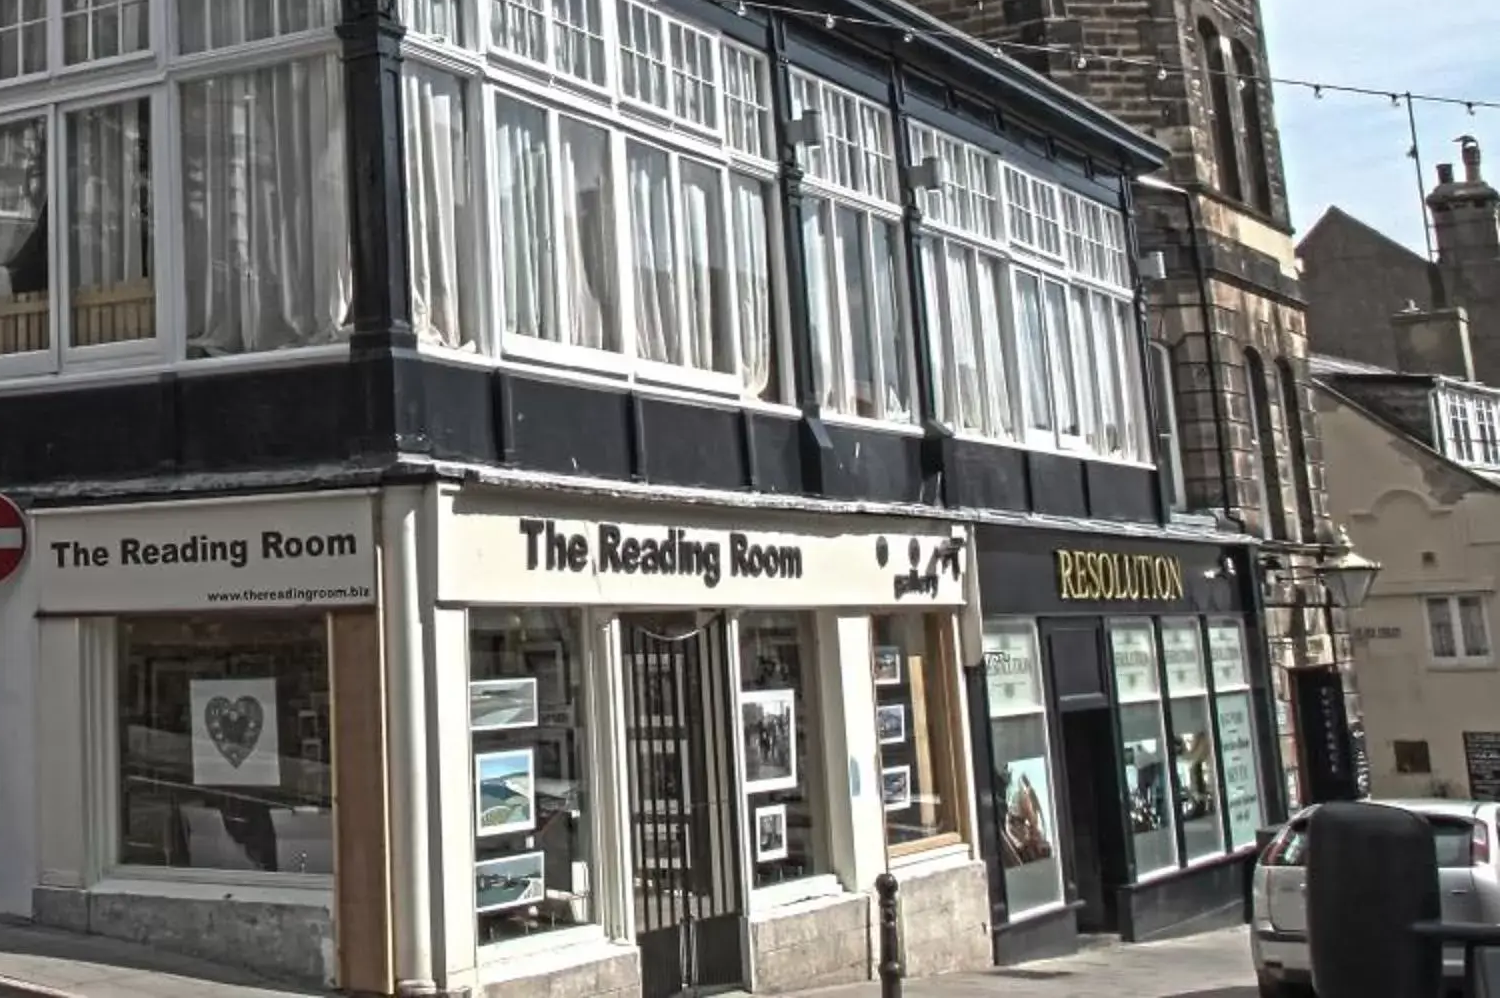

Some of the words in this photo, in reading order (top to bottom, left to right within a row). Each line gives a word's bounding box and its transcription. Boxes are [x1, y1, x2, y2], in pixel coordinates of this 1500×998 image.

[50, 541, 109, 569] The
[121, 535, 248, 568] Reading
[261, 530, 357, 559] Room
[519, 518, 588, 572] The
[598, 523, 721, 588] Reading
[730, 532, 804, 579] Room
[207, 586, 371, 603] www.thereadingroom.biz
[1056, 549, 1184, 601] RESOLUTION
